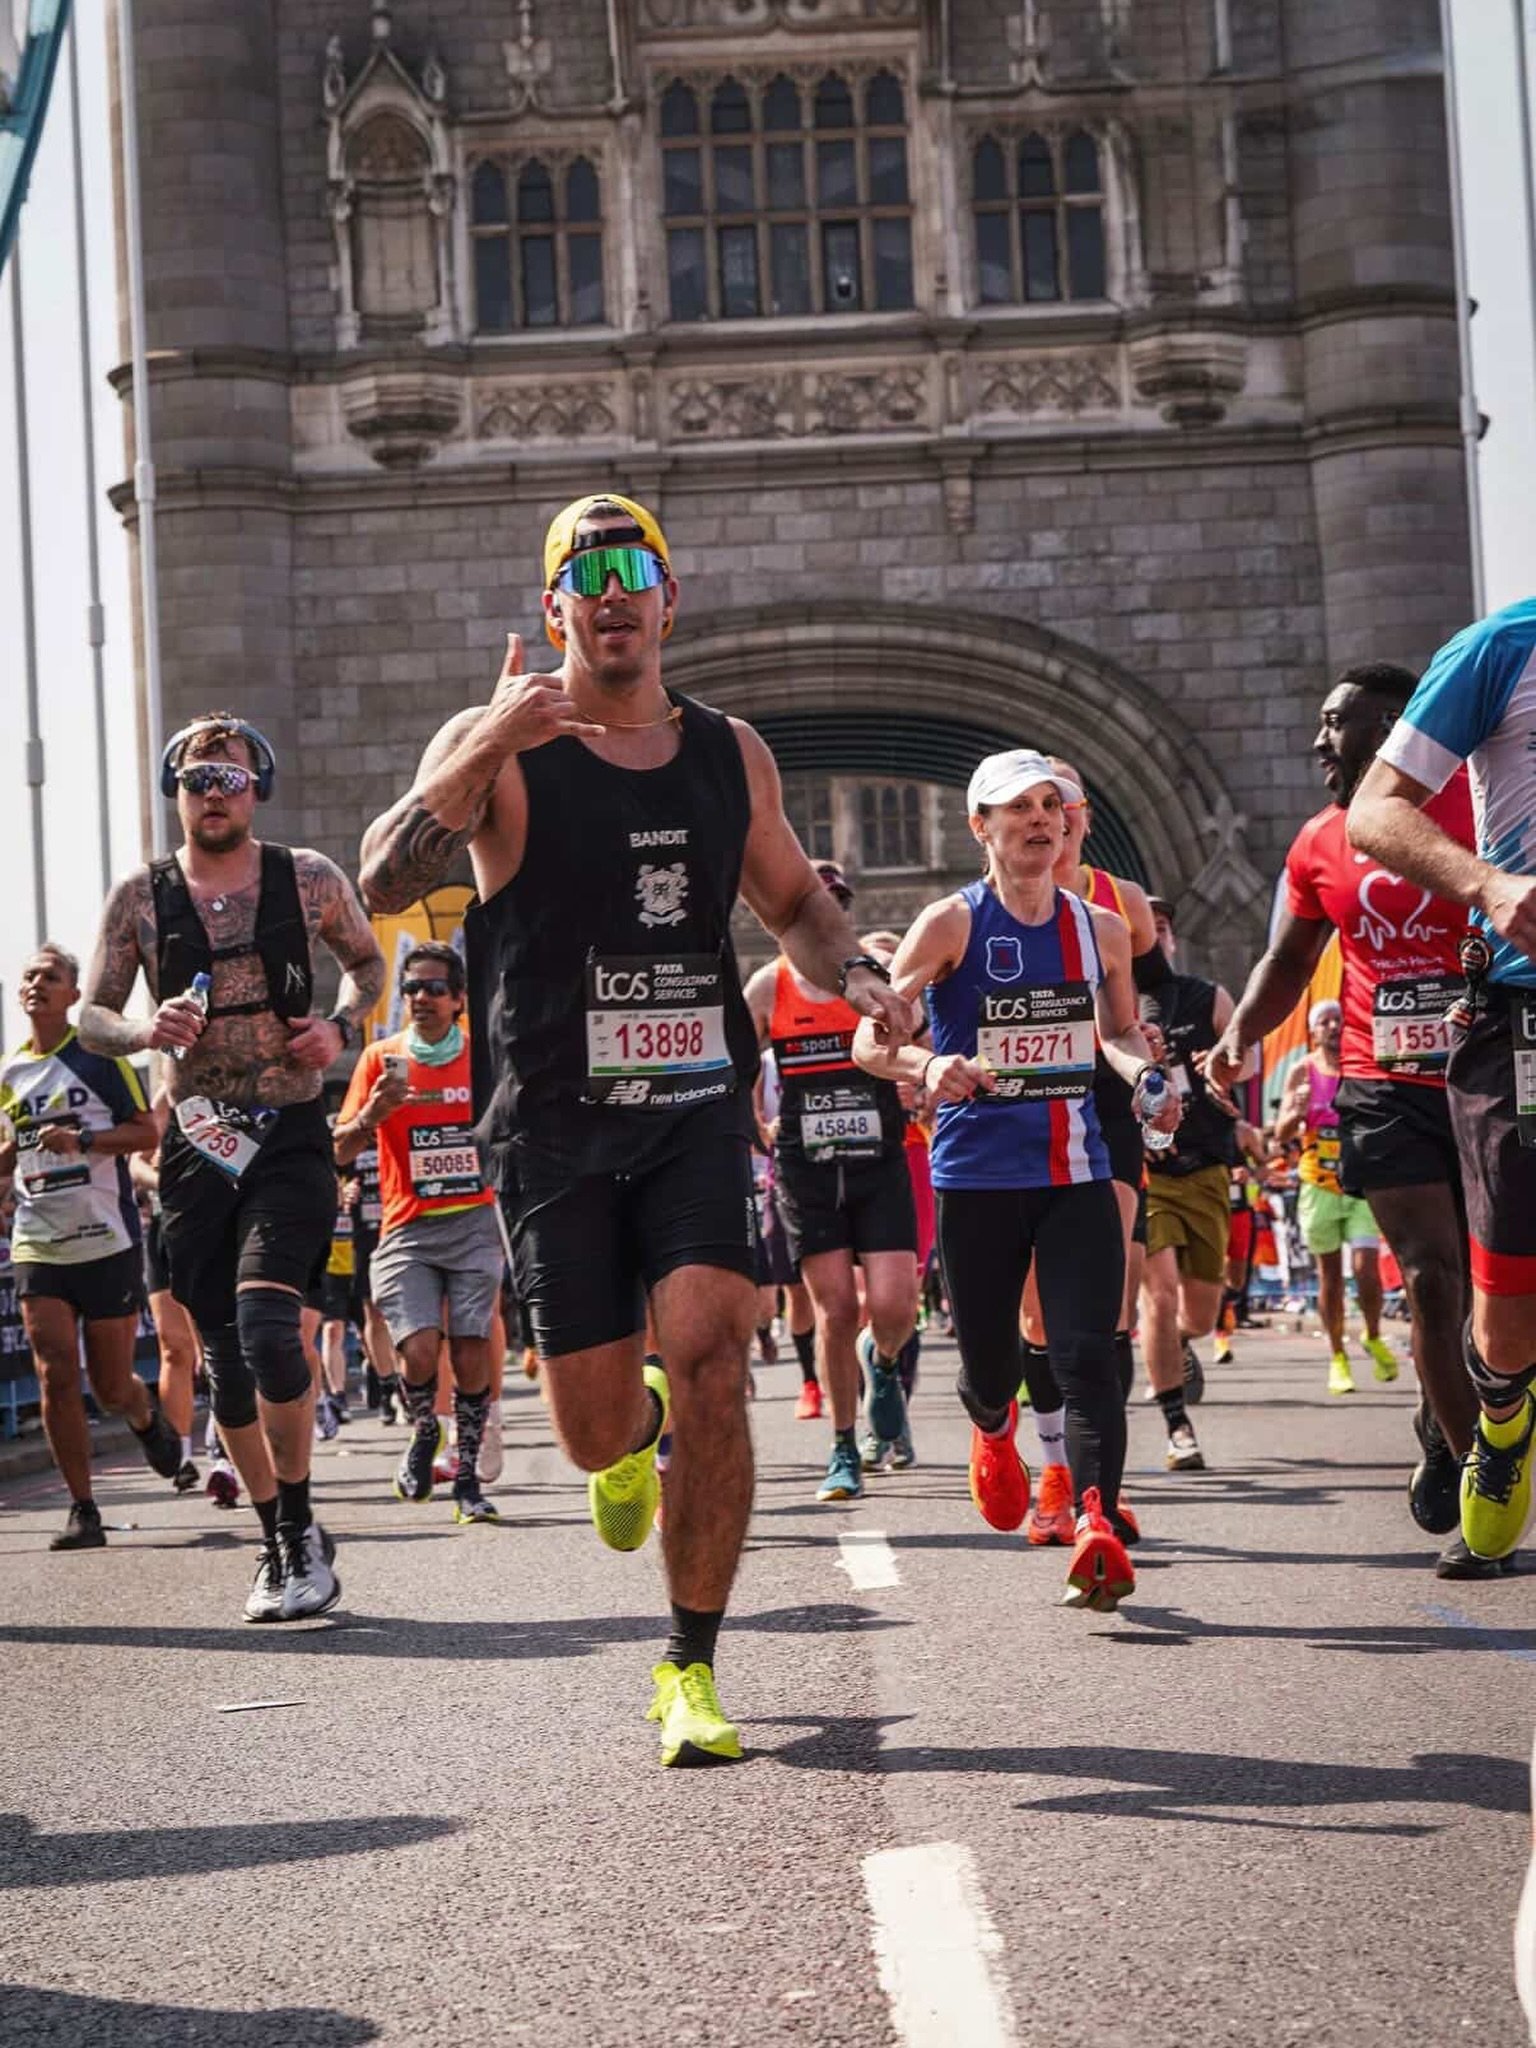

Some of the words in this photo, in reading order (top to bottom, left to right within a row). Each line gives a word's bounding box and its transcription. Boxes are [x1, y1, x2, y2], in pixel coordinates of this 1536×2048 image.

[629, 830, 689, 848] BANDIT
[652, 963, 684, 975] TATA
[595, 965, 650, 1001] tcs
[985, 994, 1028, 1021] tcs
[1031, 997, 1088, 1009] CONSULTANCY
[1378, 987, 1416, 1010] tcs
[1031, 1008, 1069, 1019] SERVICES
[615, 1020, 704, 1060] 13898
[1391, 1022, 1449, 1050] 1551
[999, 1032, 1074, 1065] 15271
[674, 1082, 727, 1103] balance
[1045, 1085, 1087, 1096] balance
[815, 1116, 868, 1137] 45848
